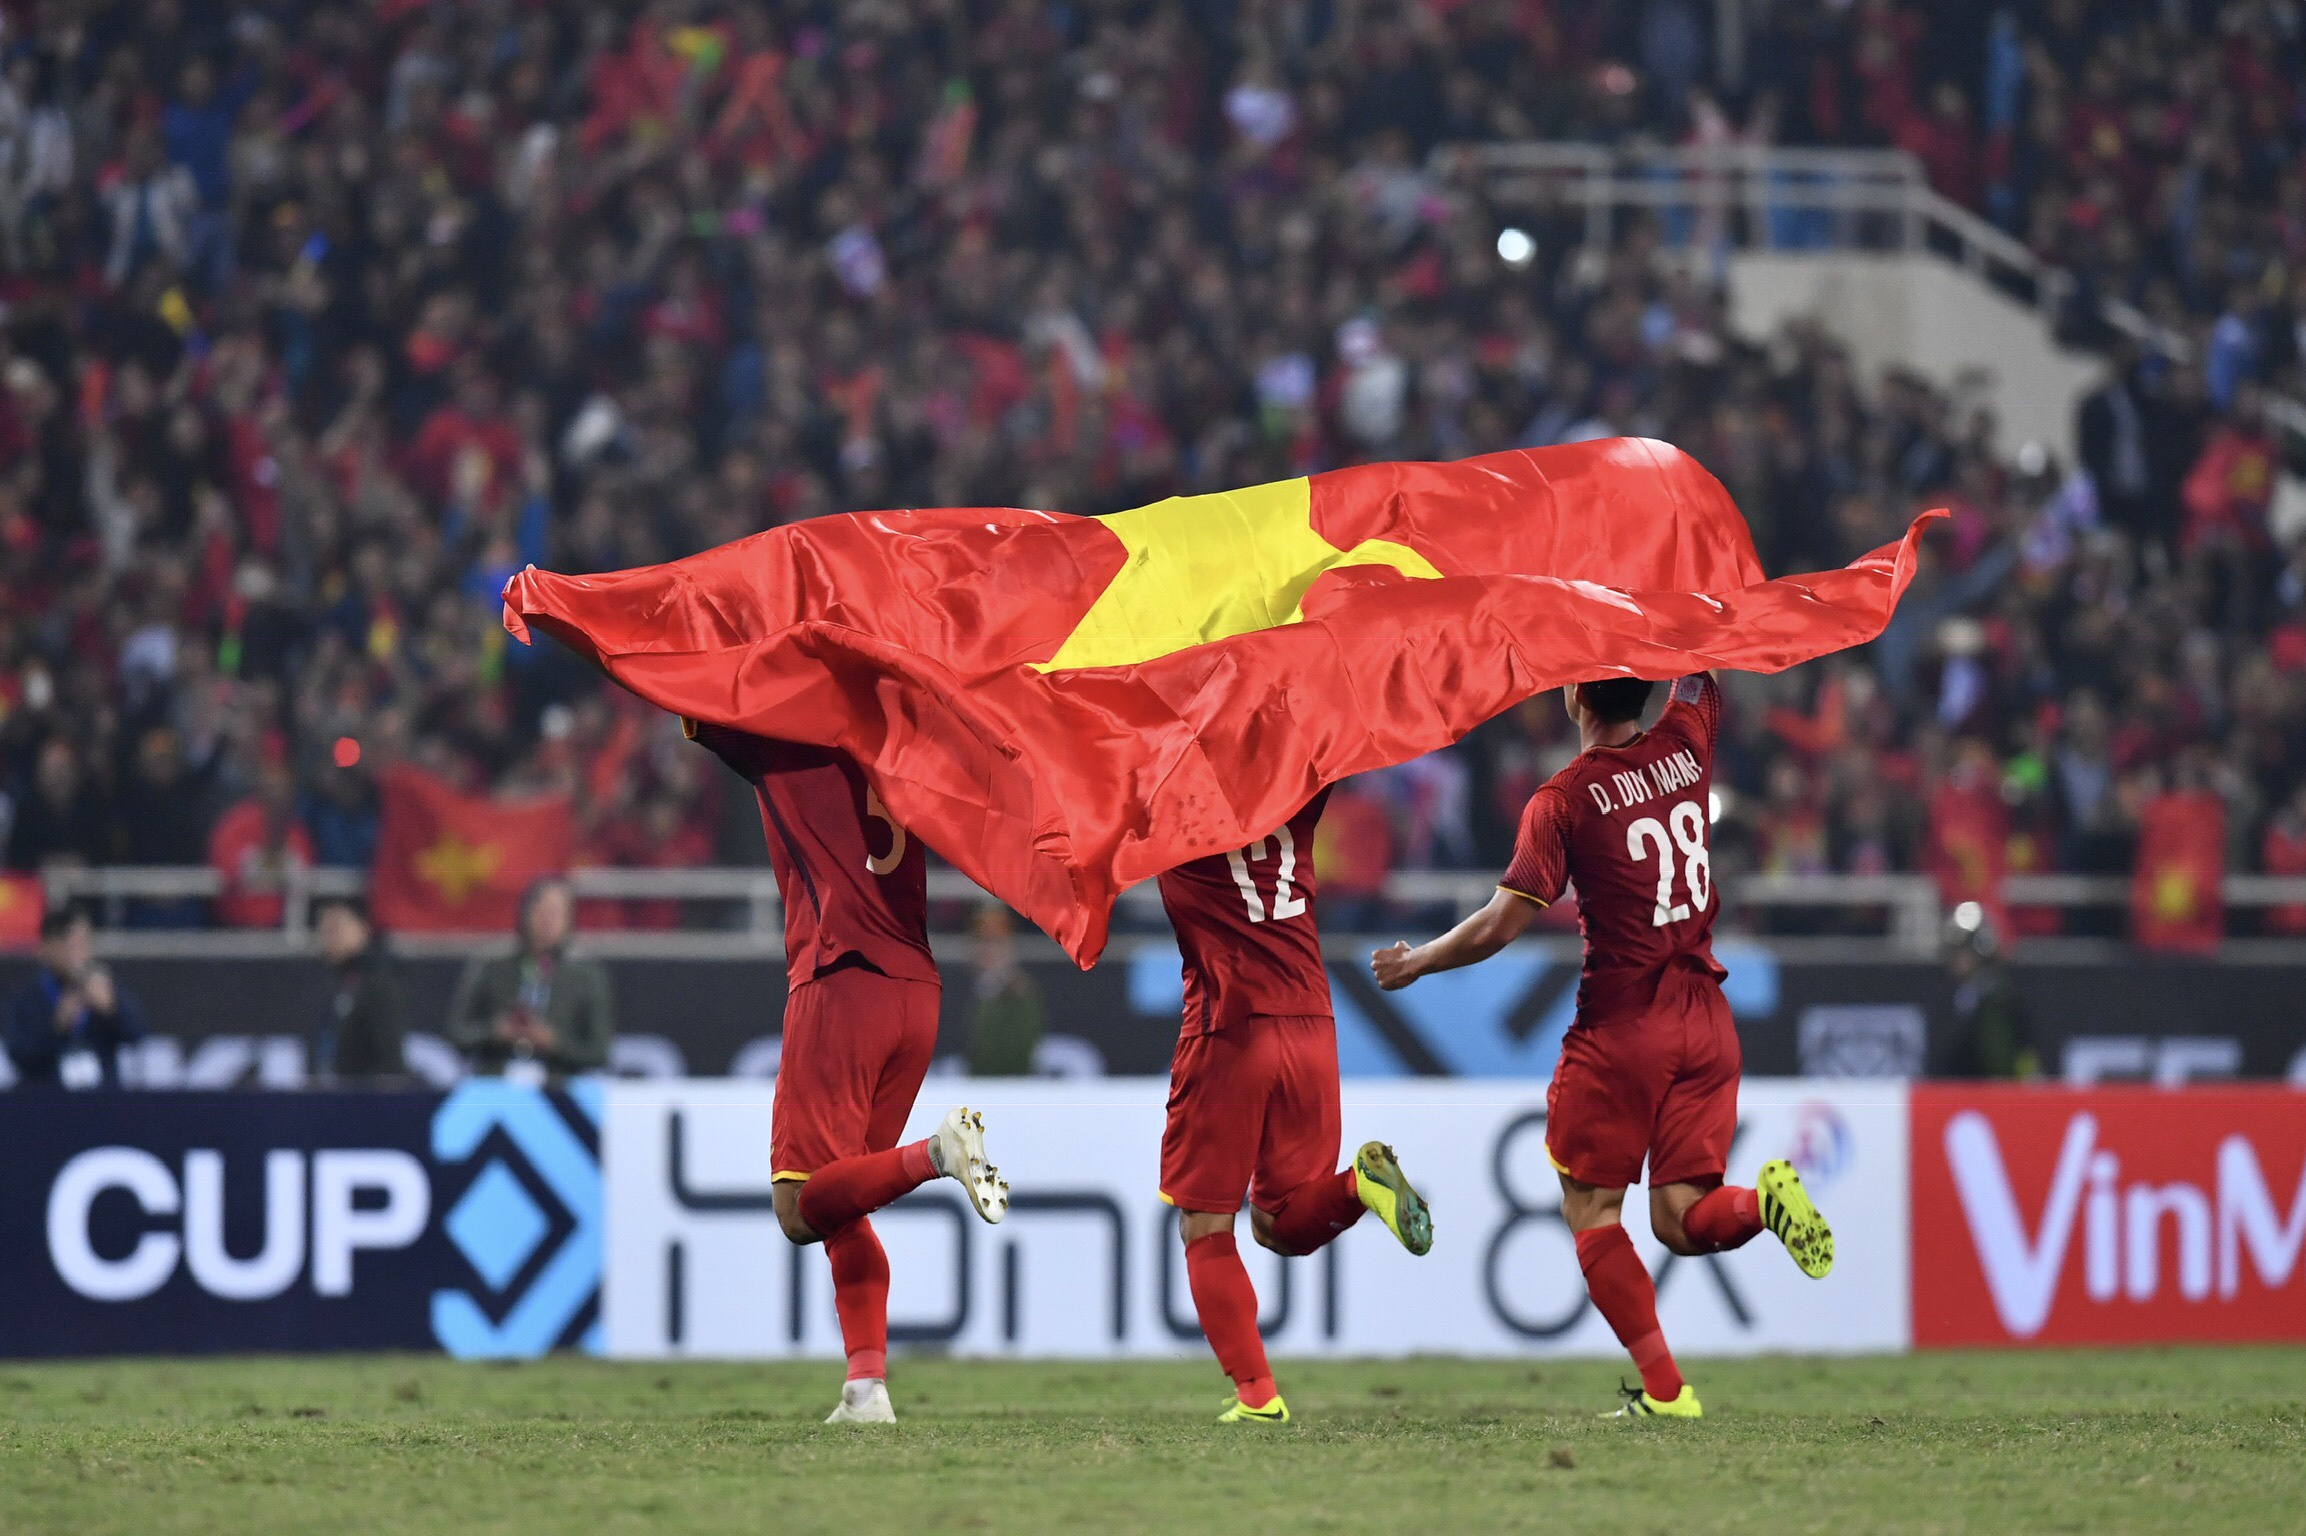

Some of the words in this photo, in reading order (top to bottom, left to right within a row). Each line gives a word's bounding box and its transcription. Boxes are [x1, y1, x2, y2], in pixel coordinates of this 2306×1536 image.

[1587, 783, 1619, 815] D.
[1611, 769, 1653, 807] DUY
[1226, 824, 1306, 923] 12
[1626, 801, 1710, 927] 28
[47, 1146, 431, 1300] CUP
